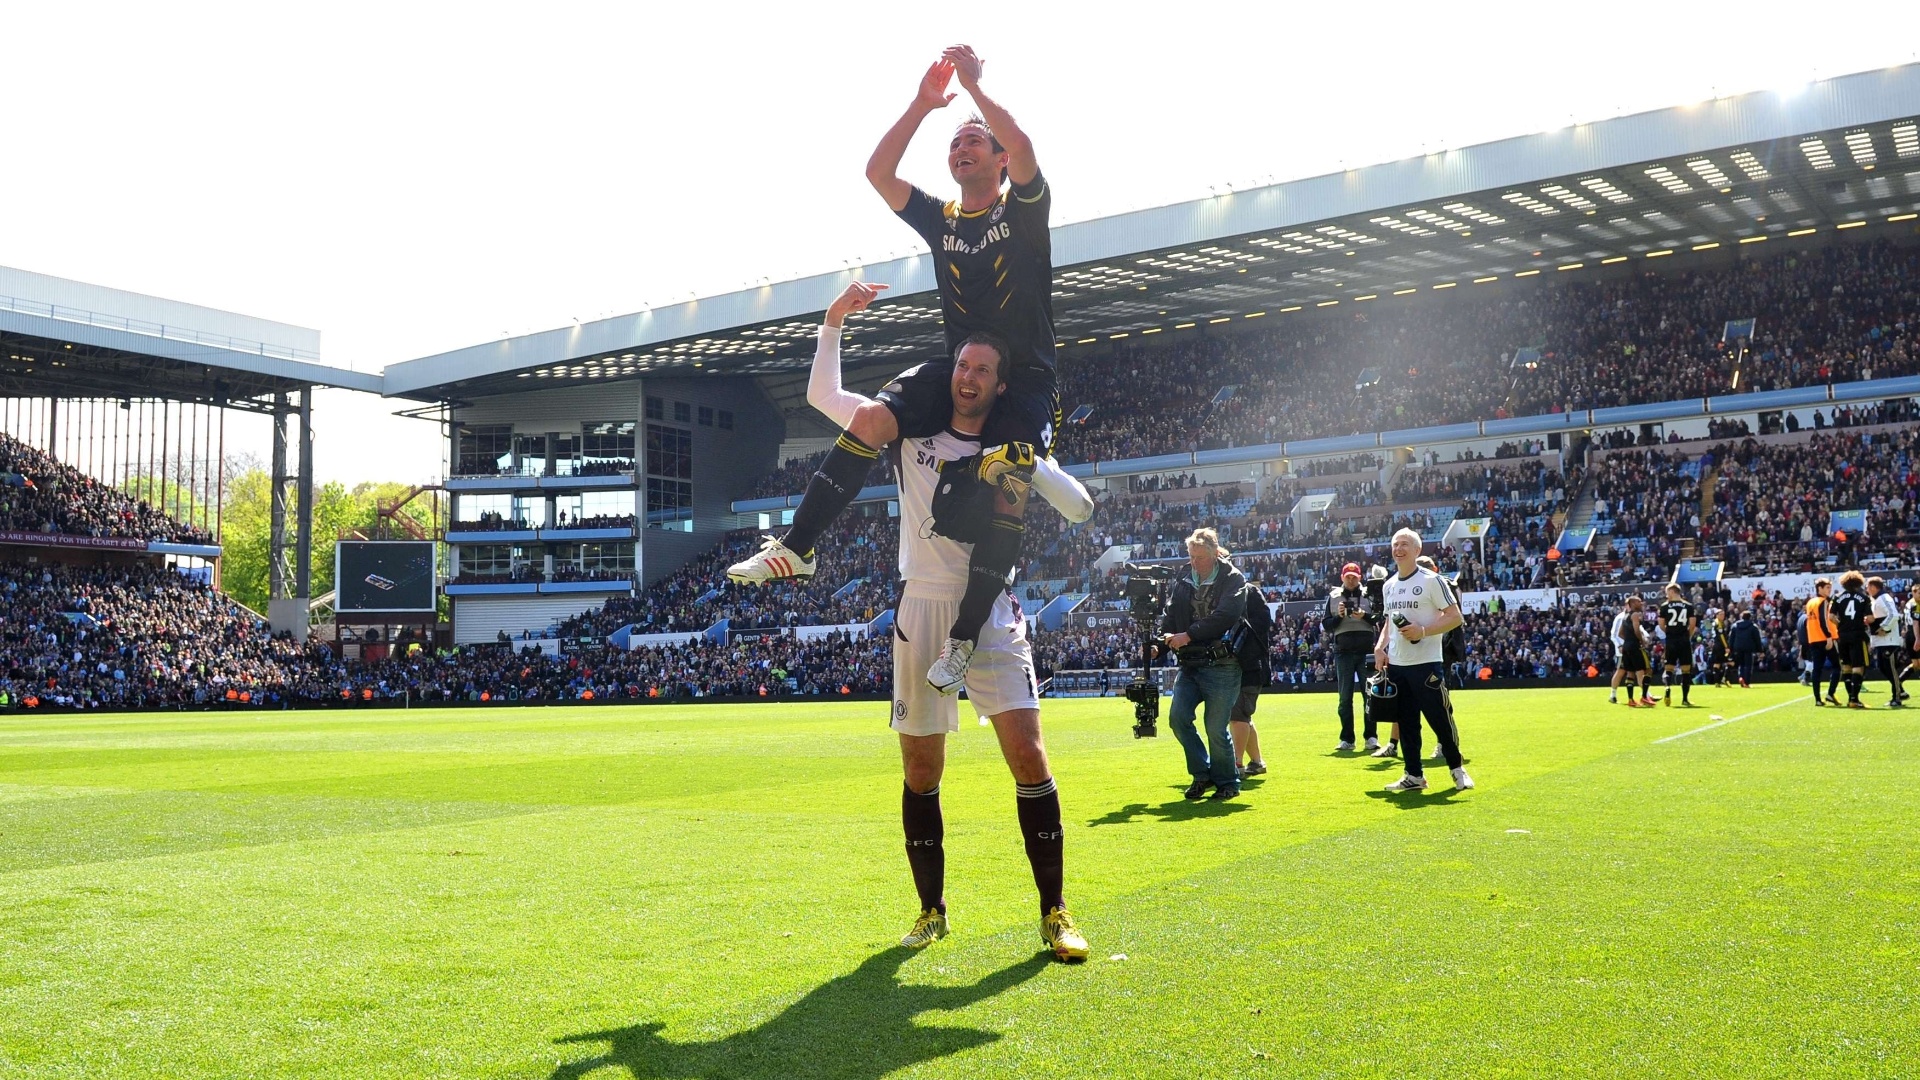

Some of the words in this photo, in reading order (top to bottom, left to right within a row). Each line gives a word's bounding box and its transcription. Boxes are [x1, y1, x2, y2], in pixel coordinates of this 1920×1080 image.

[943, 222, 1010, 254] SAMSUNG
[917, 451, 938, 472] SA
[25, 534, 57, 543] RINGING
[92, 537, 119, 547] CLARET
[973, 566, 1004, 580] CHELSEA
[1387, 601, 1419, 611] AMSUNG
[1844, 600, 1856, 620] 4
[1667, 608, 1688, 626] 24
